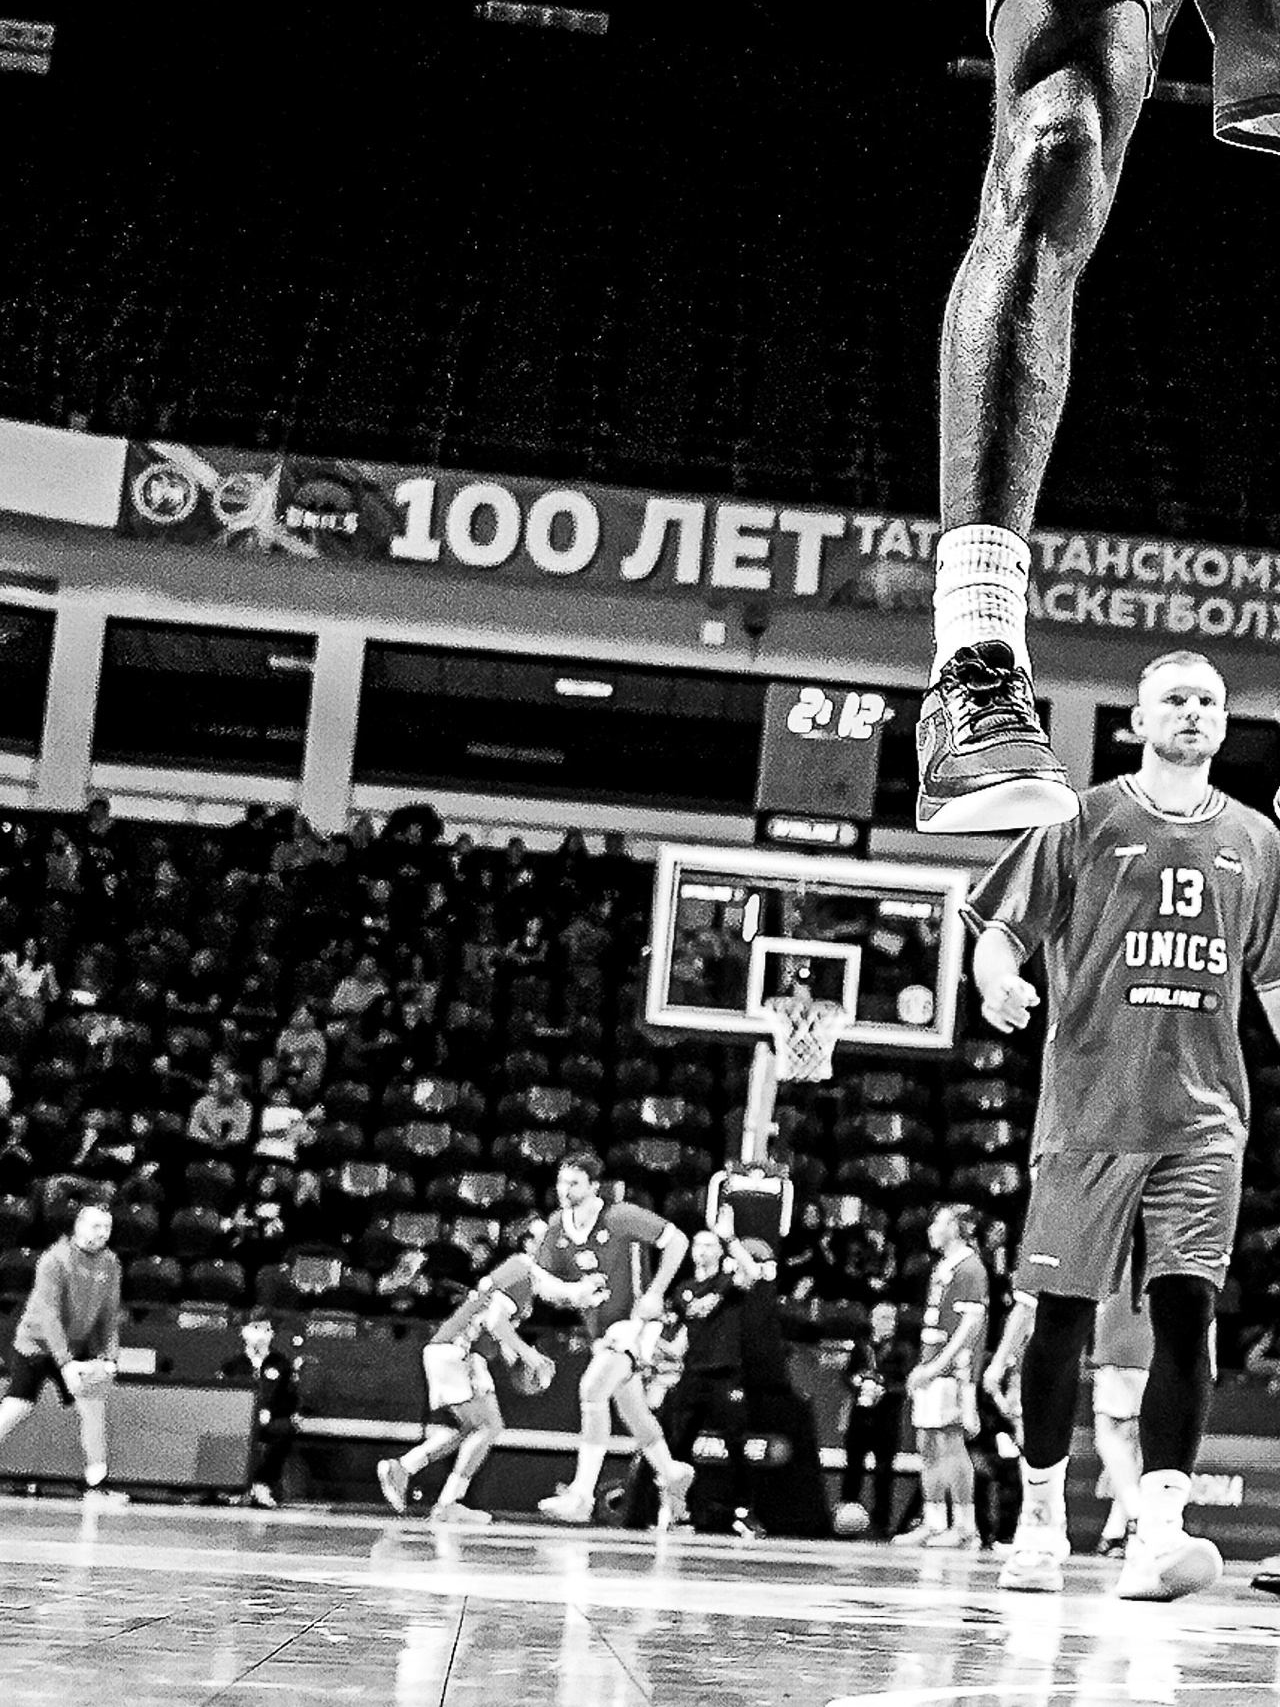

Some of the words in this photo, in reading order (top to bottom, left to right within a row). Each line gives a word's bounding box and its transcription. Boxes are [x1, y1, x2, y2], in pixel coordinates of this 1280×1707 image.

[390, 477, 600, 575] 100
[620, 497, 846, 595] ЛЕТ
[1158, 867, 1205, 918] 13
[1124, 930, 1229, 976] UNICS
